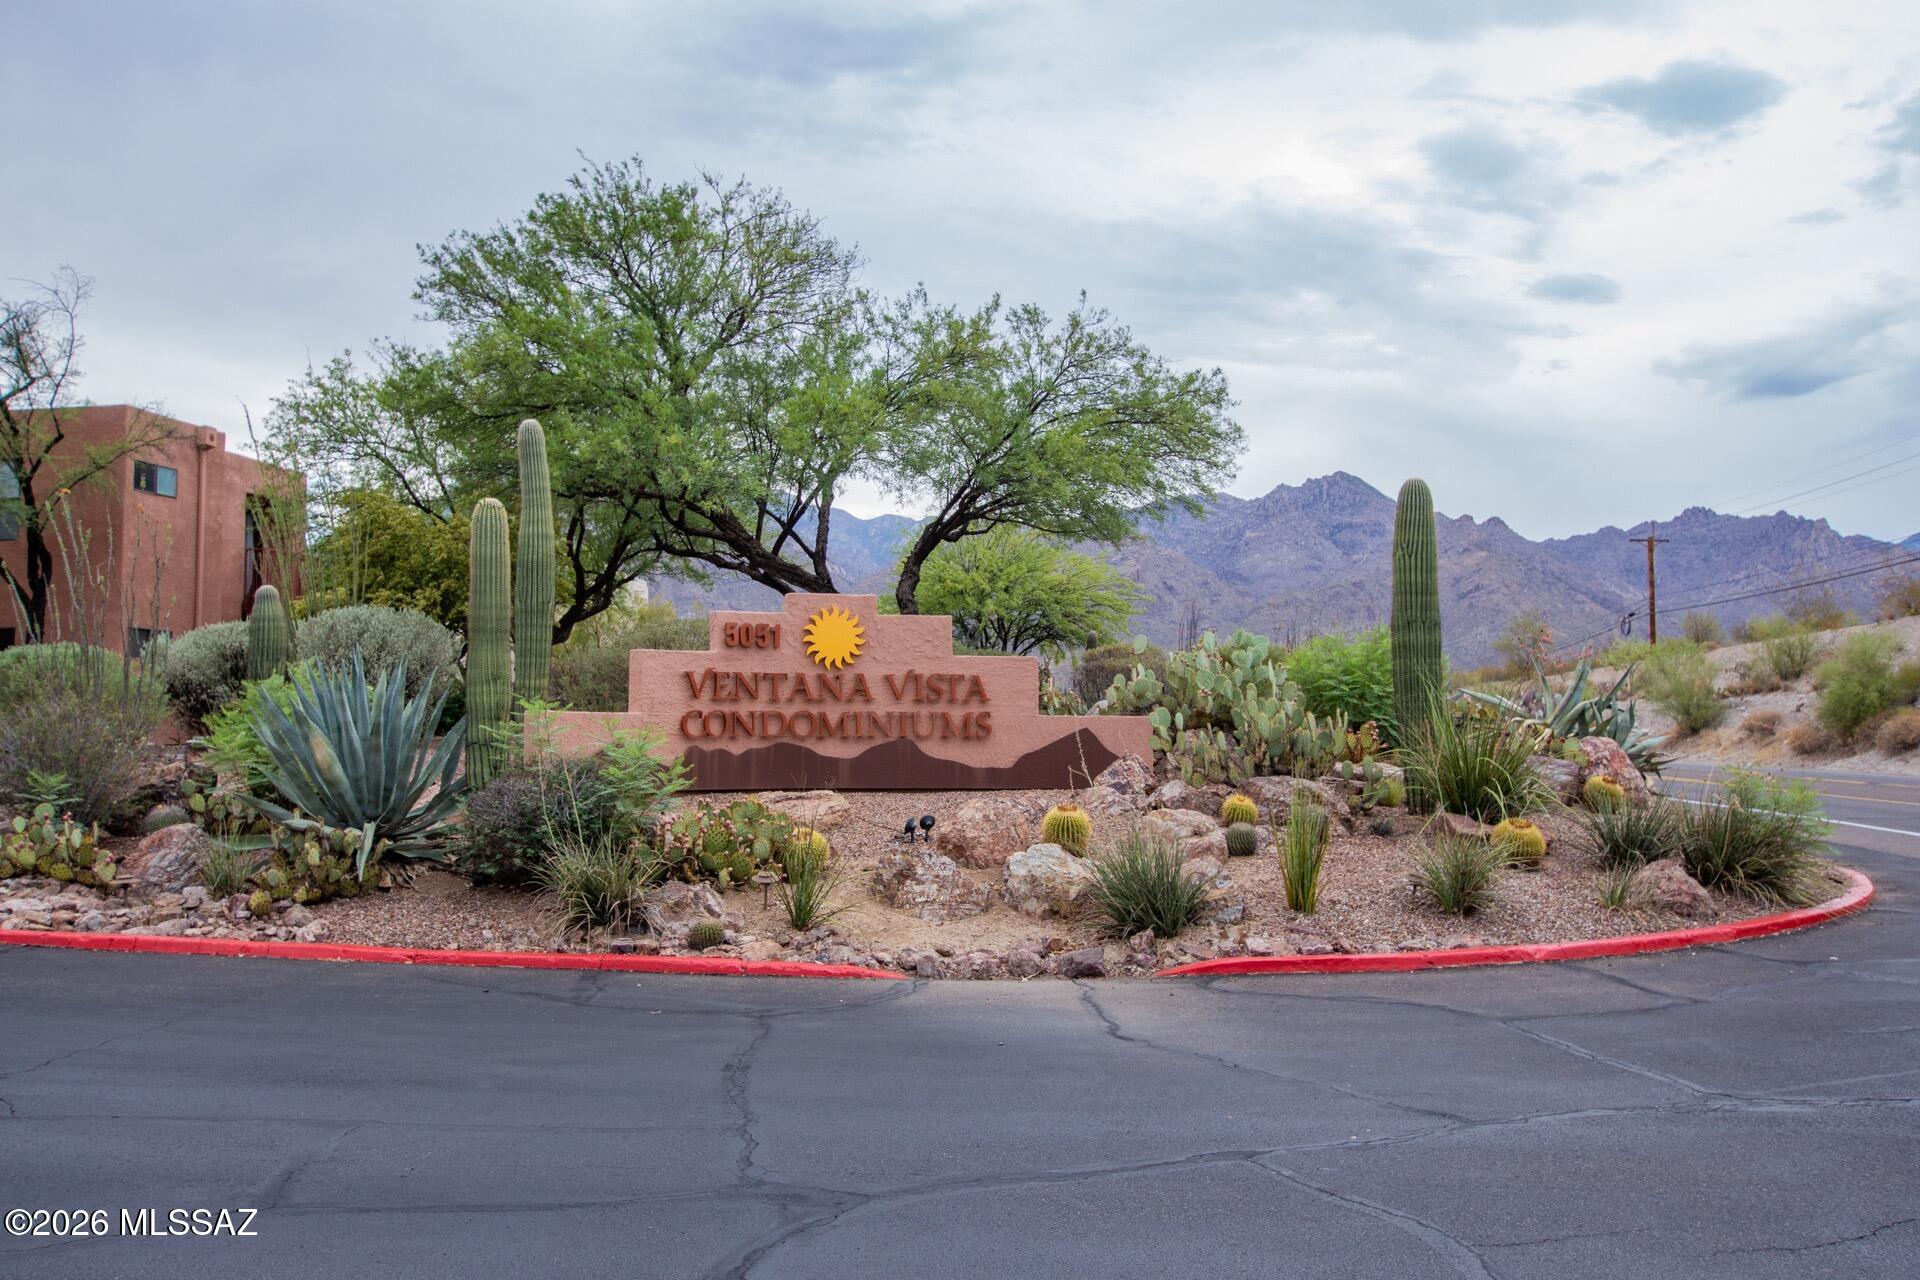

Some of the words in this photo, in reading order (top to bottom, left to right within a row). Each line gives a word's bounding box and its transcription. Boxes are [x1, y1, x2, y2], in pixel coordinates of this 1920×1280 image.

[724, 622, 781, 649] 5051
[684, 667, 871, 702] VENTANA
[884, 669, 990, 702] VISTA
[681, 710, 993, 740] CONDOMINIUMS
